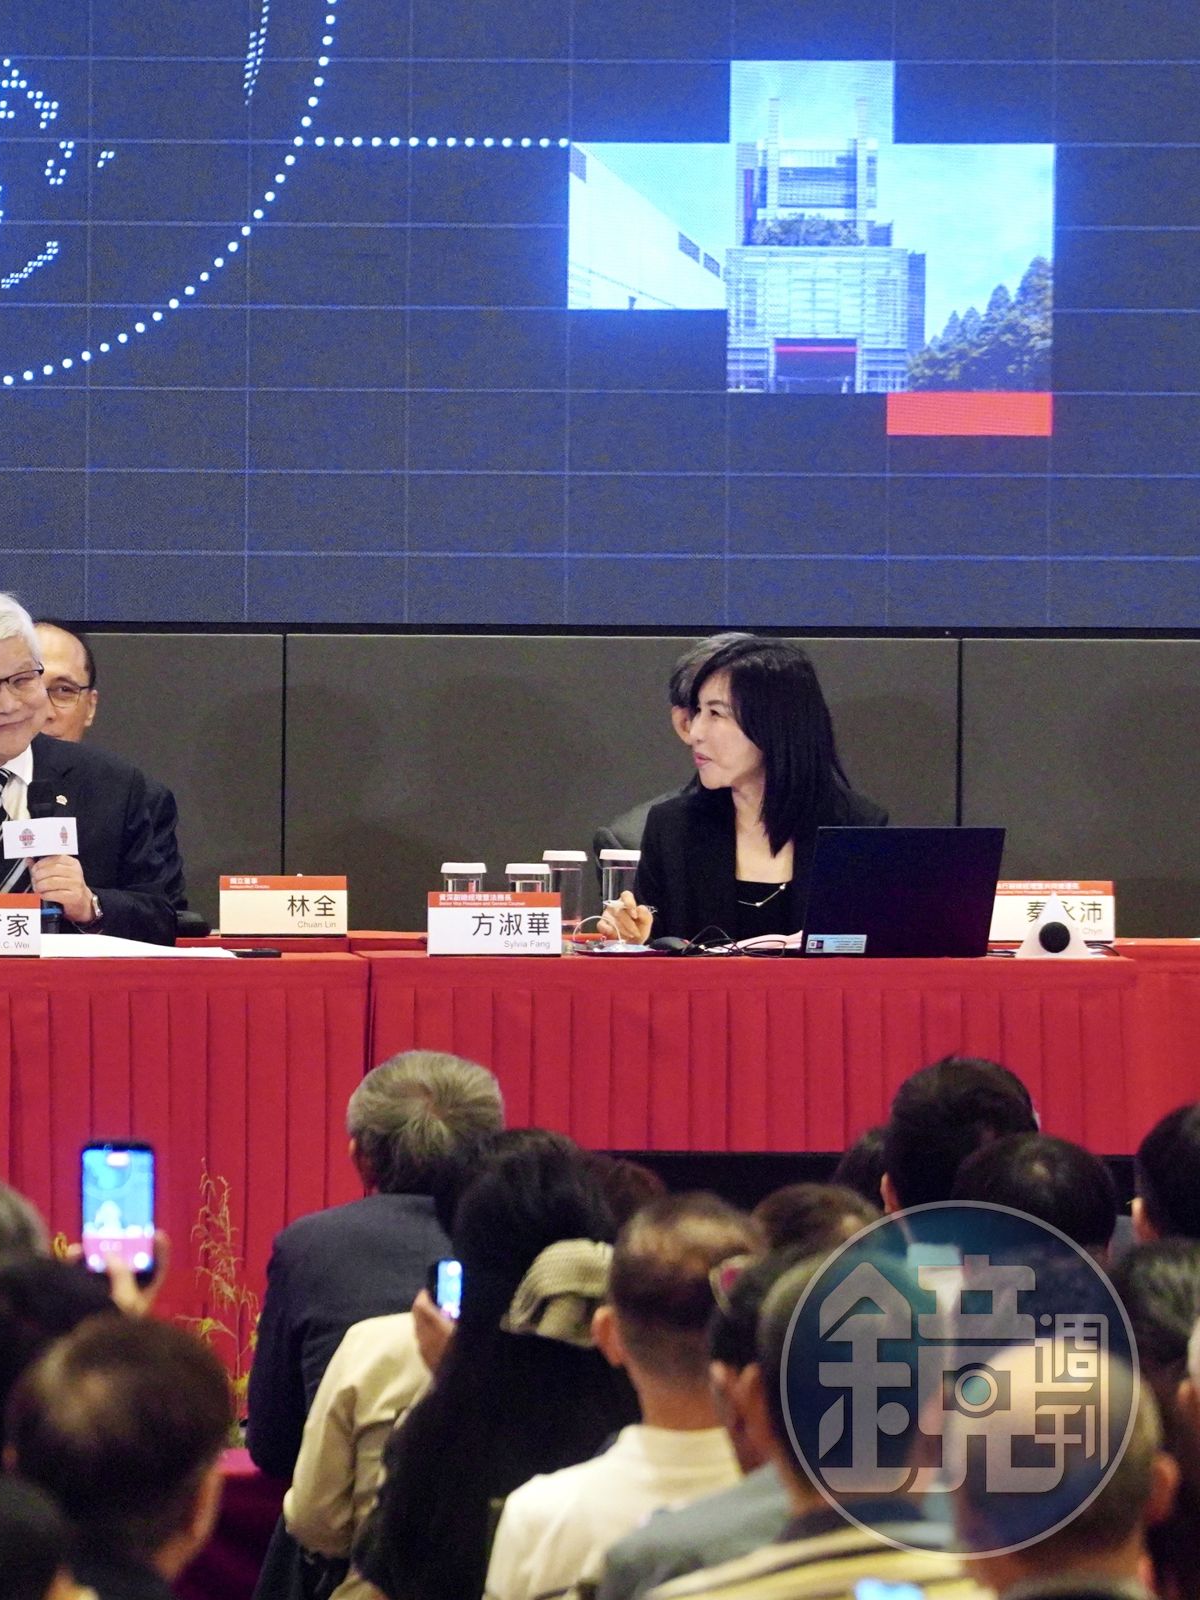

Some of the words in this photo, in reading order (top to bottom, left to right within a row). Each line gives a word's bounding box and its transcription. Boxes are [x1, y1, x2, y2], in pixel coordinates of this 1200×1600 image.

[287, 894, 336, 917] 林全
[297, 920, 323, 928] Chuan
[325, 920, 336, 928] Lin
[472, 912, 550, 936] 方淑華
[14, 941, 30, 949] Wei
[504, 940, 528, 950] Sylvia
[529, 940, 550, 950] Fang
